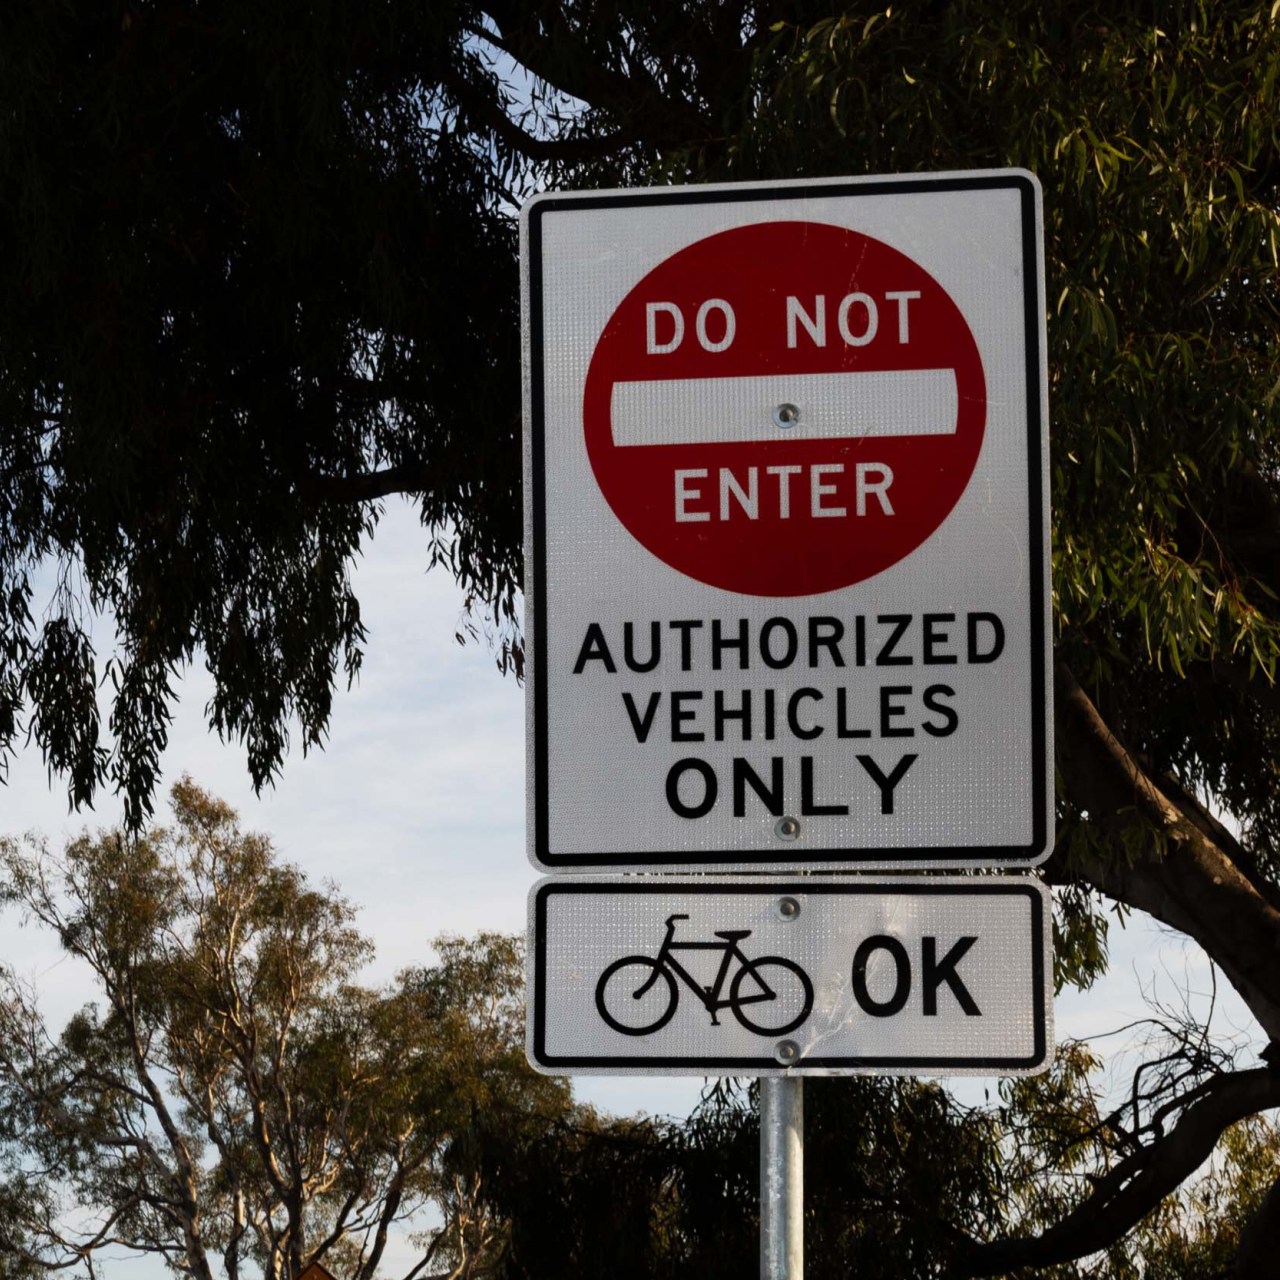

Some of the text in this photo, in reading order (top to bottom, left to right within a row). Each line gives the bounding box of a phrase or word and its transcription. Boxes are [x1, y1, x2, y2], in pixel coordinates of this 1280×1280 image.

[647, 291, 920, 354] DO NOT
[675, 463, 894, 522] ENTER
[573, 612, 1005, 674] AUTHORIZED
[622, 684, 958, 743] VEHICLES
[666, 754, 918, 819] ONLY
[852, 935, 981, 1017] OK
